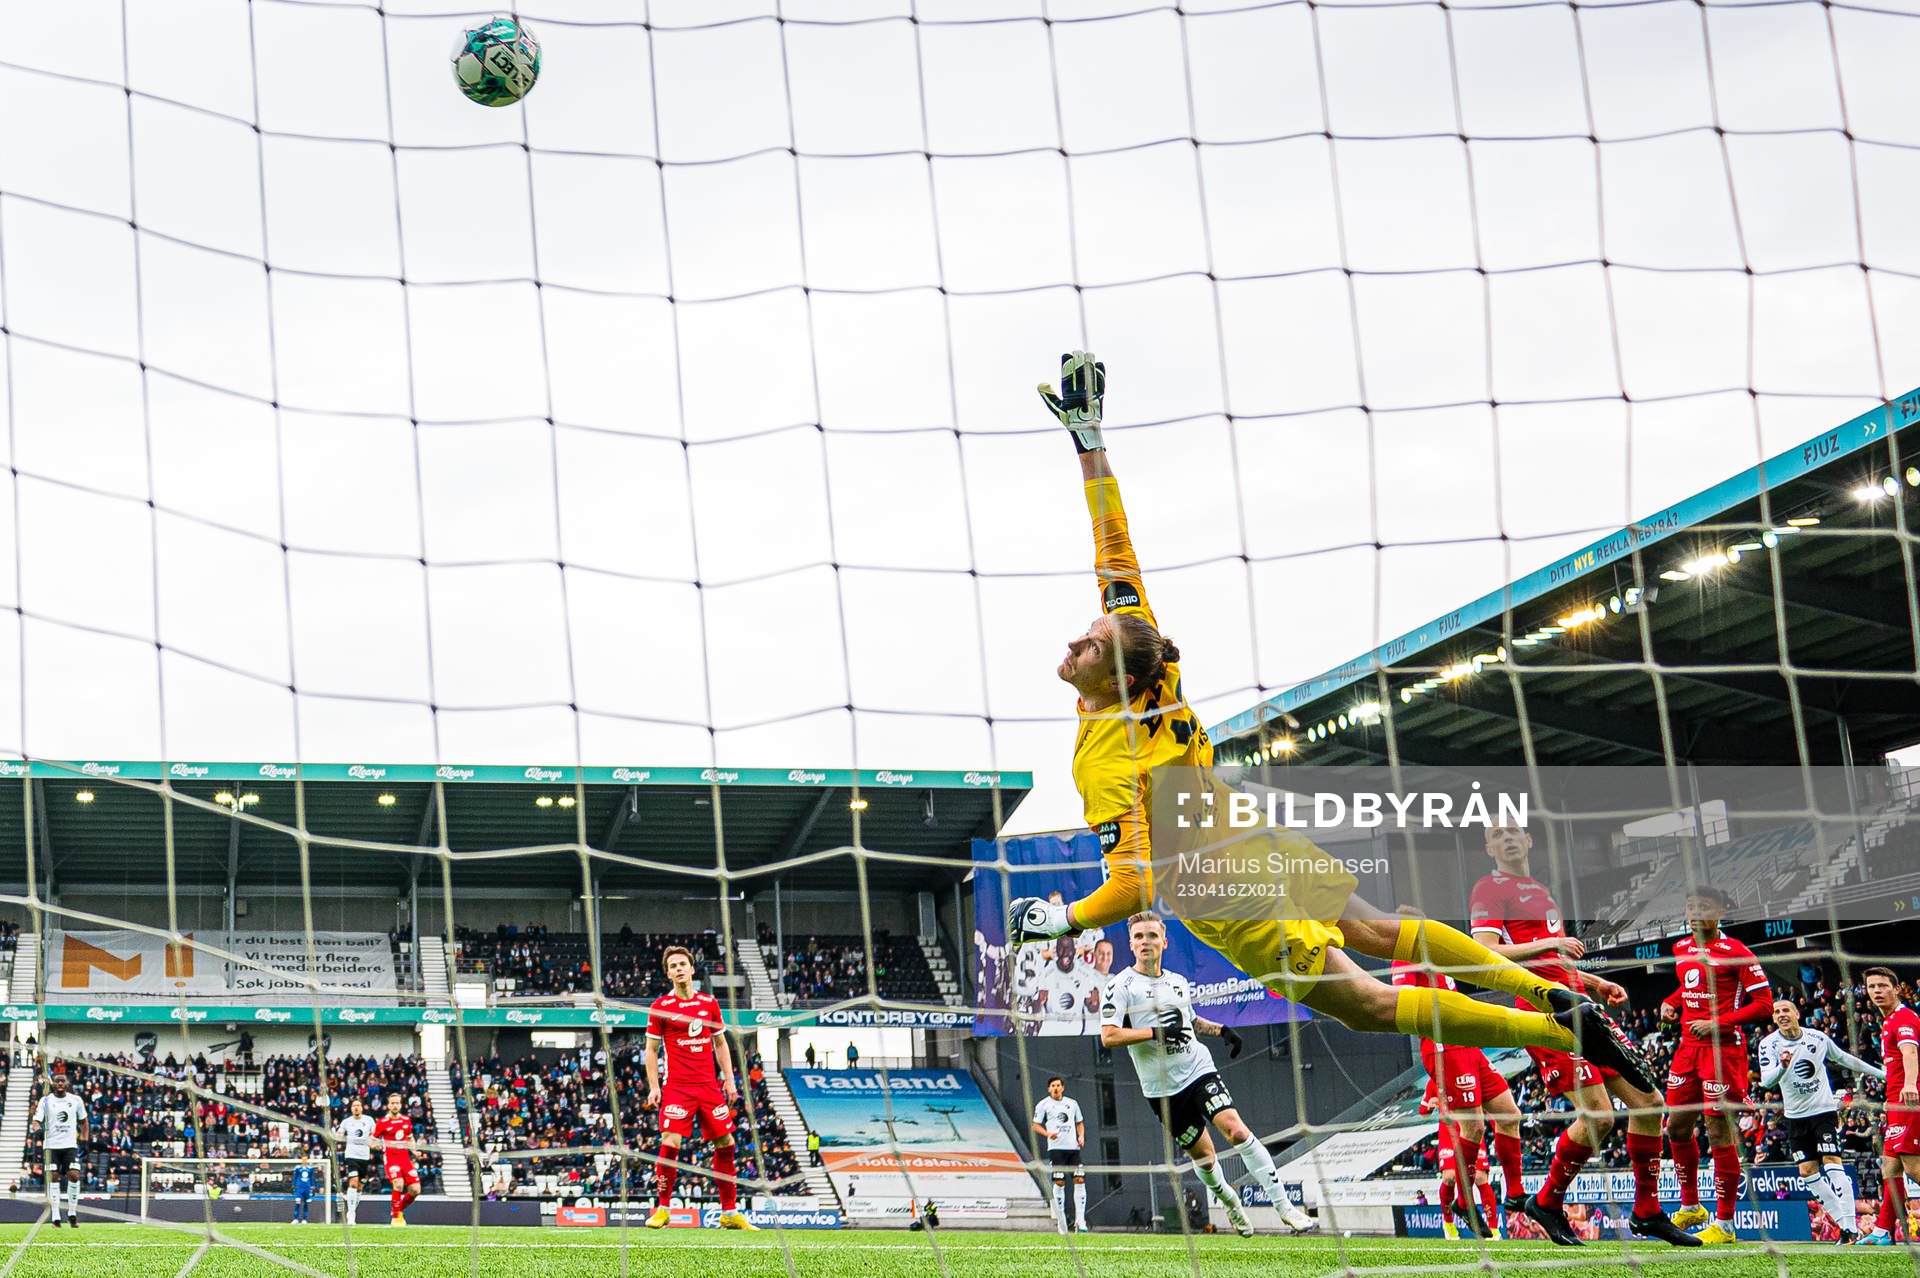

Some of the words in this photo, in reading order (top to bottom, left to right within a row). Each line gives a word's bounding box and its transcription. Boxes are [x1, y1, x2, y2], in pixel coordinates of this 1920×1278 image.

[1803, 433, 1840, 465] FJUZ
[1550, 562, 1572, 584] DITT
[1574, 550, 1595, 573] NYE
[1106, 595, 1138, 608] altibox
[1439, 612, 1461, 636] FJUZ
[1387, 639, 1407, 661] FJUZ
[1765, 919, 1794, 938] FJUZ
[245, 936, 265, 945] du
[270, 936, 302, 946] best
[345, 938, 383, 947] ball?
[245, 952, 260, 960] Vi
[264, 952, 322, 963] trenger
[325, 952, 361, 963] flere
[1636, 943, 1660, 960] FJUZ
[236, 979, 265, 989] Søk
[268, 979, 305, 990] jobb
[1189, 977, 1264, 998] SpareBank
[1576, 1065, 1593, 1081] 21
[800, 1073, 962, 1090] Rauland
[1462, 1091, 1475, 1103] 19
[1817, 1143, 1836, 1153] ABB
[1577, 1175, 1605, 1192] Røsholt
[1612, 1175, 1635, 1191] Røsho
[1421, 1214, 1444, 1229] VALGF
[1603, 1216, 1630, 1229] Domin
[1734, 1210, 1778, 1230] UESDAY!
